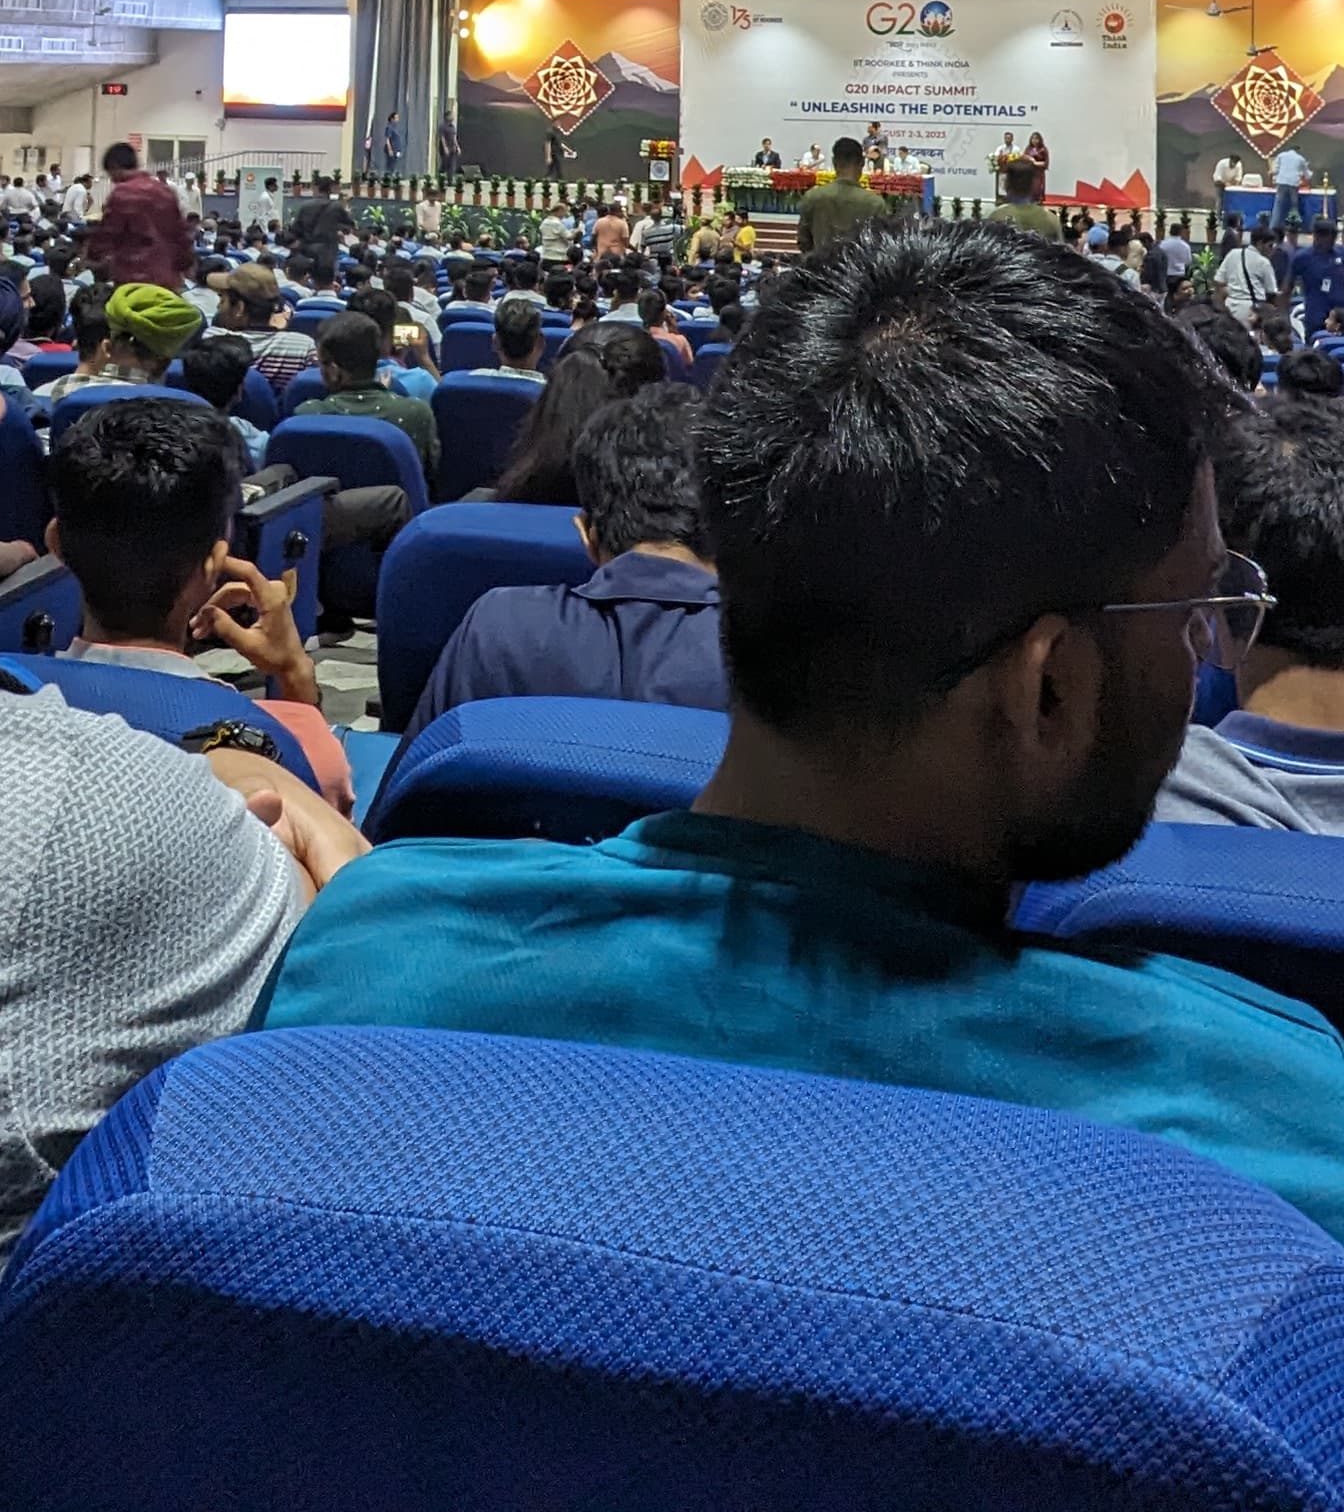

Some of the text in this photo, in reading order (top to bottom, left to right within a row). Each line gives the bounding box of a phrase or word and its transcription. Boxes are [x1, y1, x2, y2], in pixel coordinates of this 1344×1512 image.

[865, 59, 906, 68] ROORKEE
[908, 59, 915, 68] &
[916, 60, 943, 68] THINK
[944, 60, 970, 69] INDIA
[845, 84, 977, 97] G20 IMPACT SUMMIT
[801, 101, 896, 114] UNLEASHING
[899, 103, 929, 115] THE
[932, 103, 1027, 117] POTENTIALS
[925, 131, 946, 139] 2023
[947, 167, 977, 176] FUTURE
